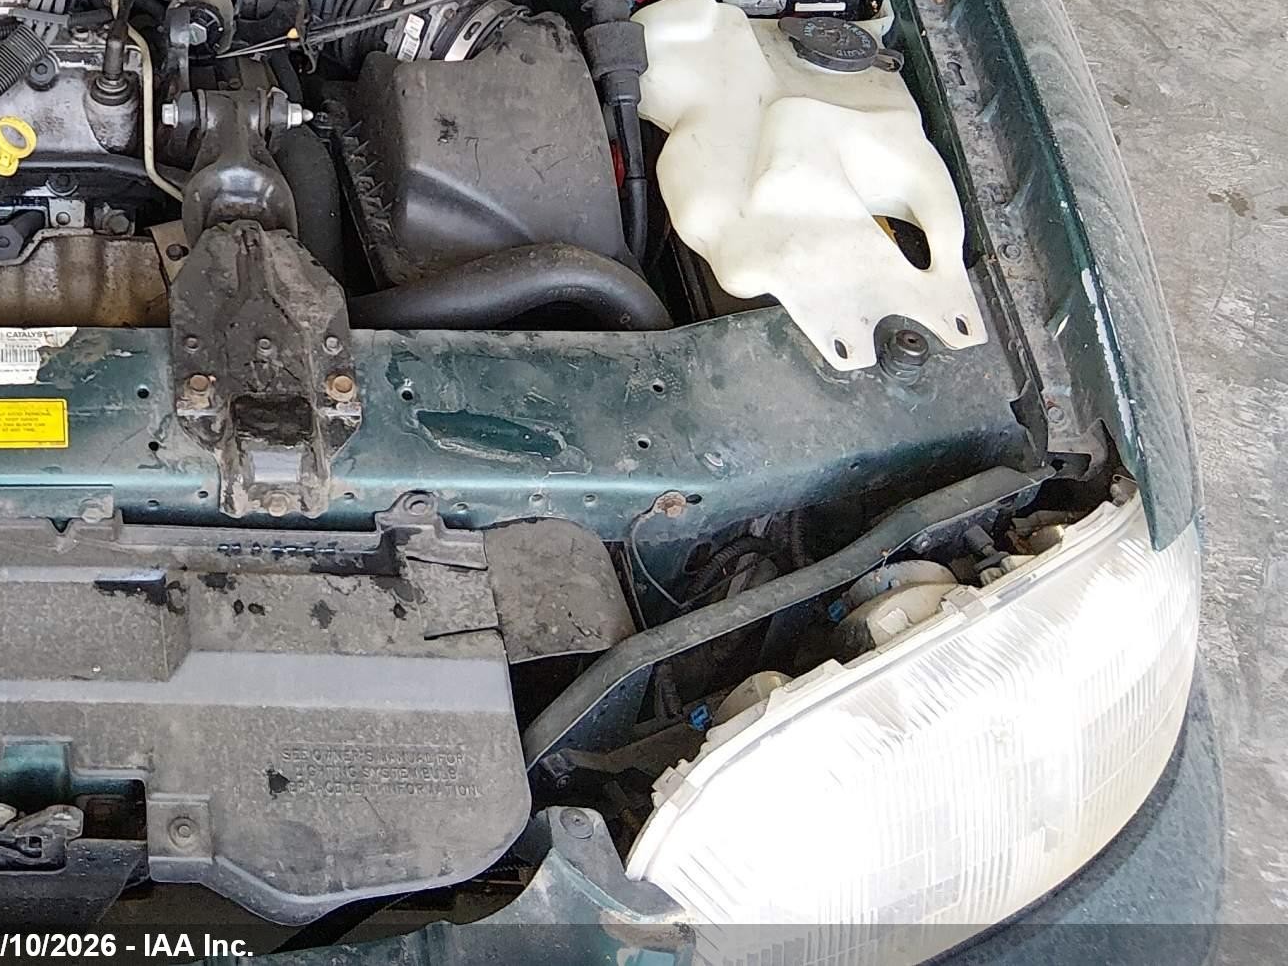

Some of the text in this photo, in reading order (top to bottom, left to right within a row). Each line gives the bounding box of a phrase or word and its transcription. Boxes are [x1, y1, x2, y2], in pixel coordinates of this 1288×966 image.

[6, 331, 47, 339] CATALYST
[280, 746, 310, 763] SEE
[436, 751, 465, 766] FOR
